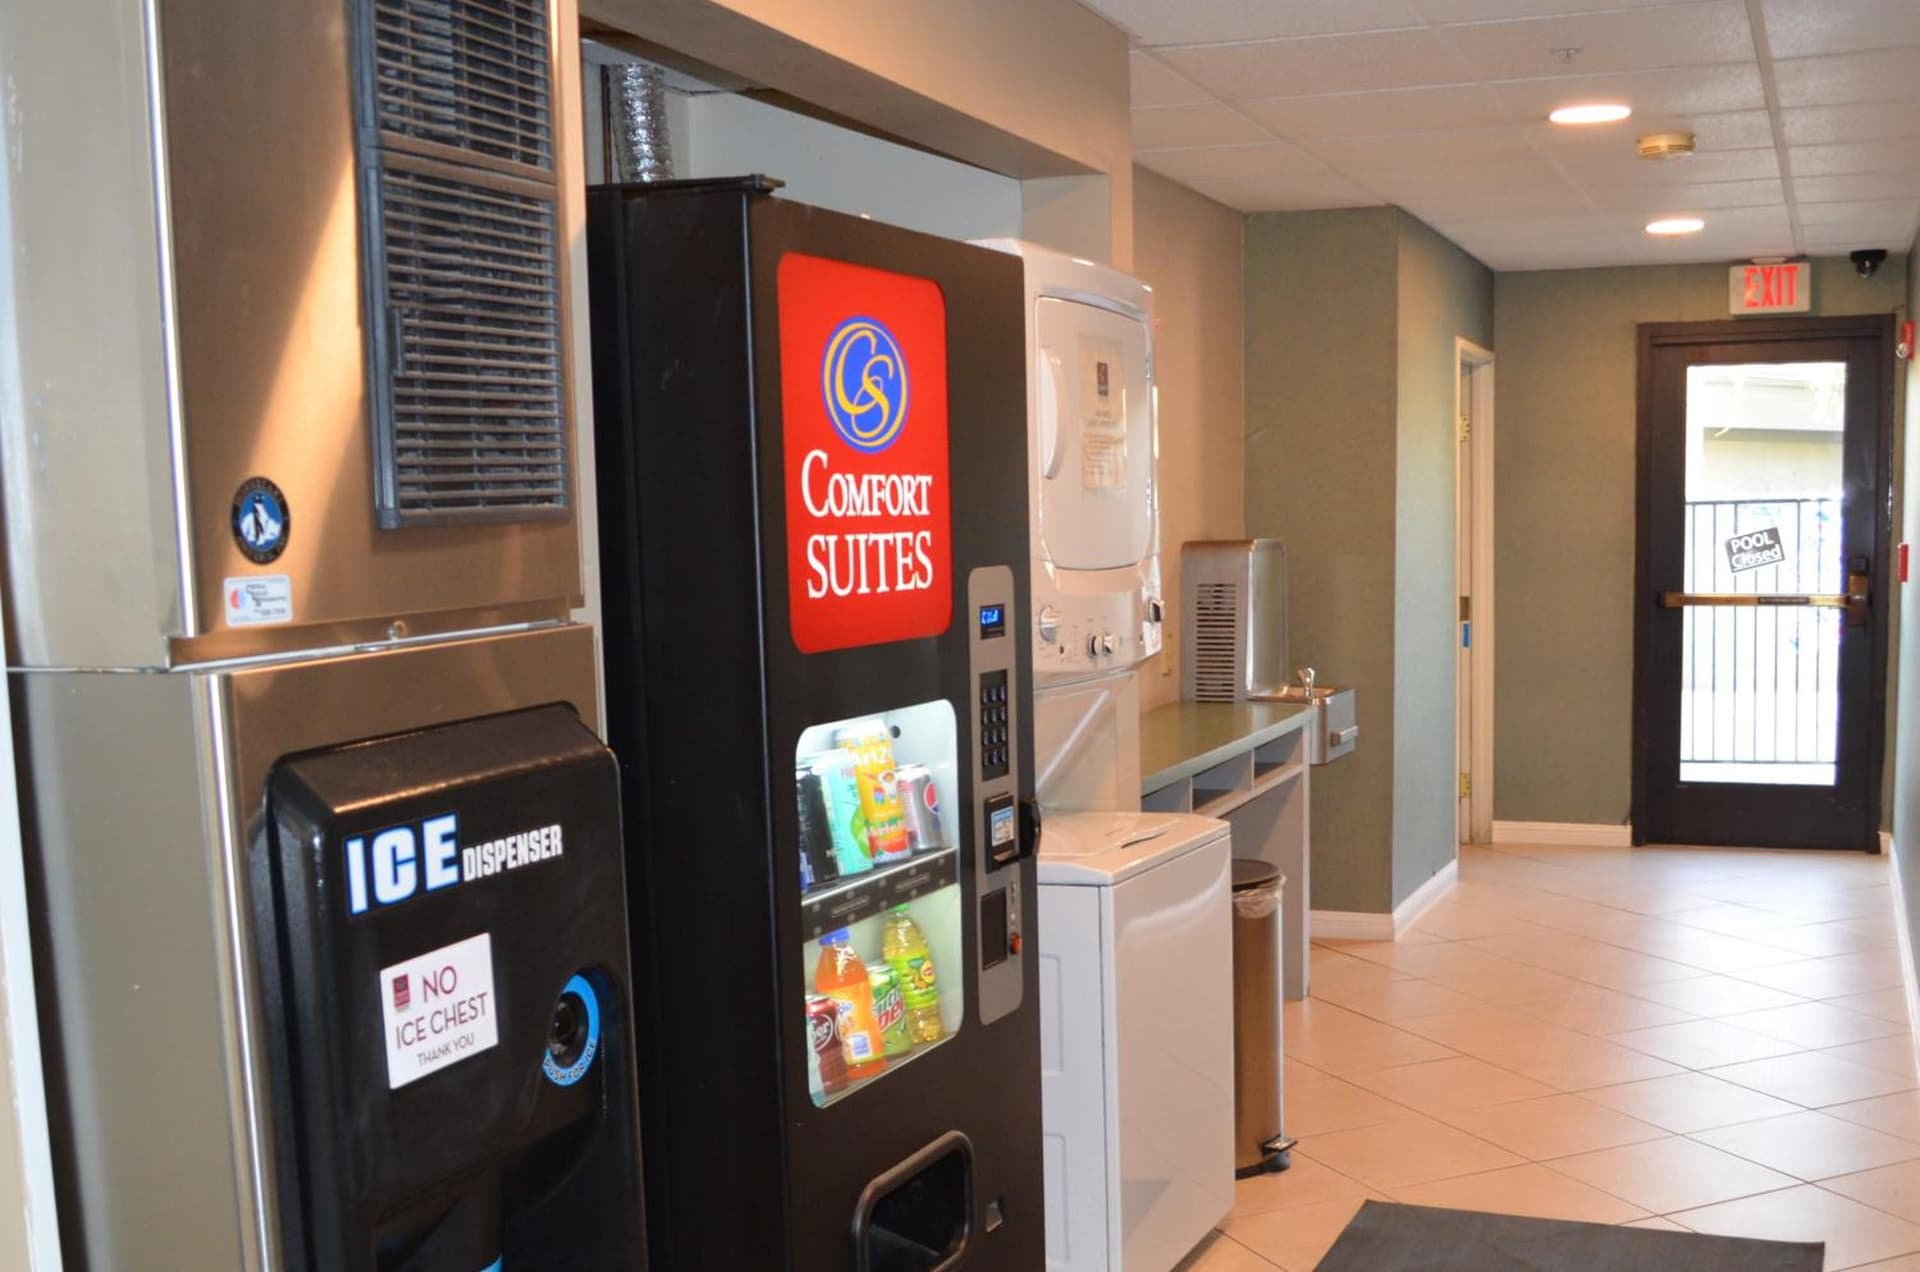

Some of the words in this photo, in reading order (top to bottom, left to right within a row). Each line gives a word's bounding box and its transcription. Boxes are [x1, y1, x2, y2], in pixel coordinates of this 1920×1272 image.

[1743, 265, 1799, 309] EXIT
[801, 449, 933, 518] COMFORT
[1730, 531, 1775, 554] POOL
[1731, 543, 1783, 569] Closed
[806, 530, 934, 599] SUITES
[345, 812, 461, 916] ICE
[462, 823, 564, 883] DISPENSER
[421, 965, 458, 1004] NO
[395, 1015, 428, 1050] ICE
[429, 991, 488, 1035] CHEST
[416, 1044, 453, 1067] THANK
[452, 1031, 476, 1052] YOU
[568, 1062, 586, 1079] FOR
